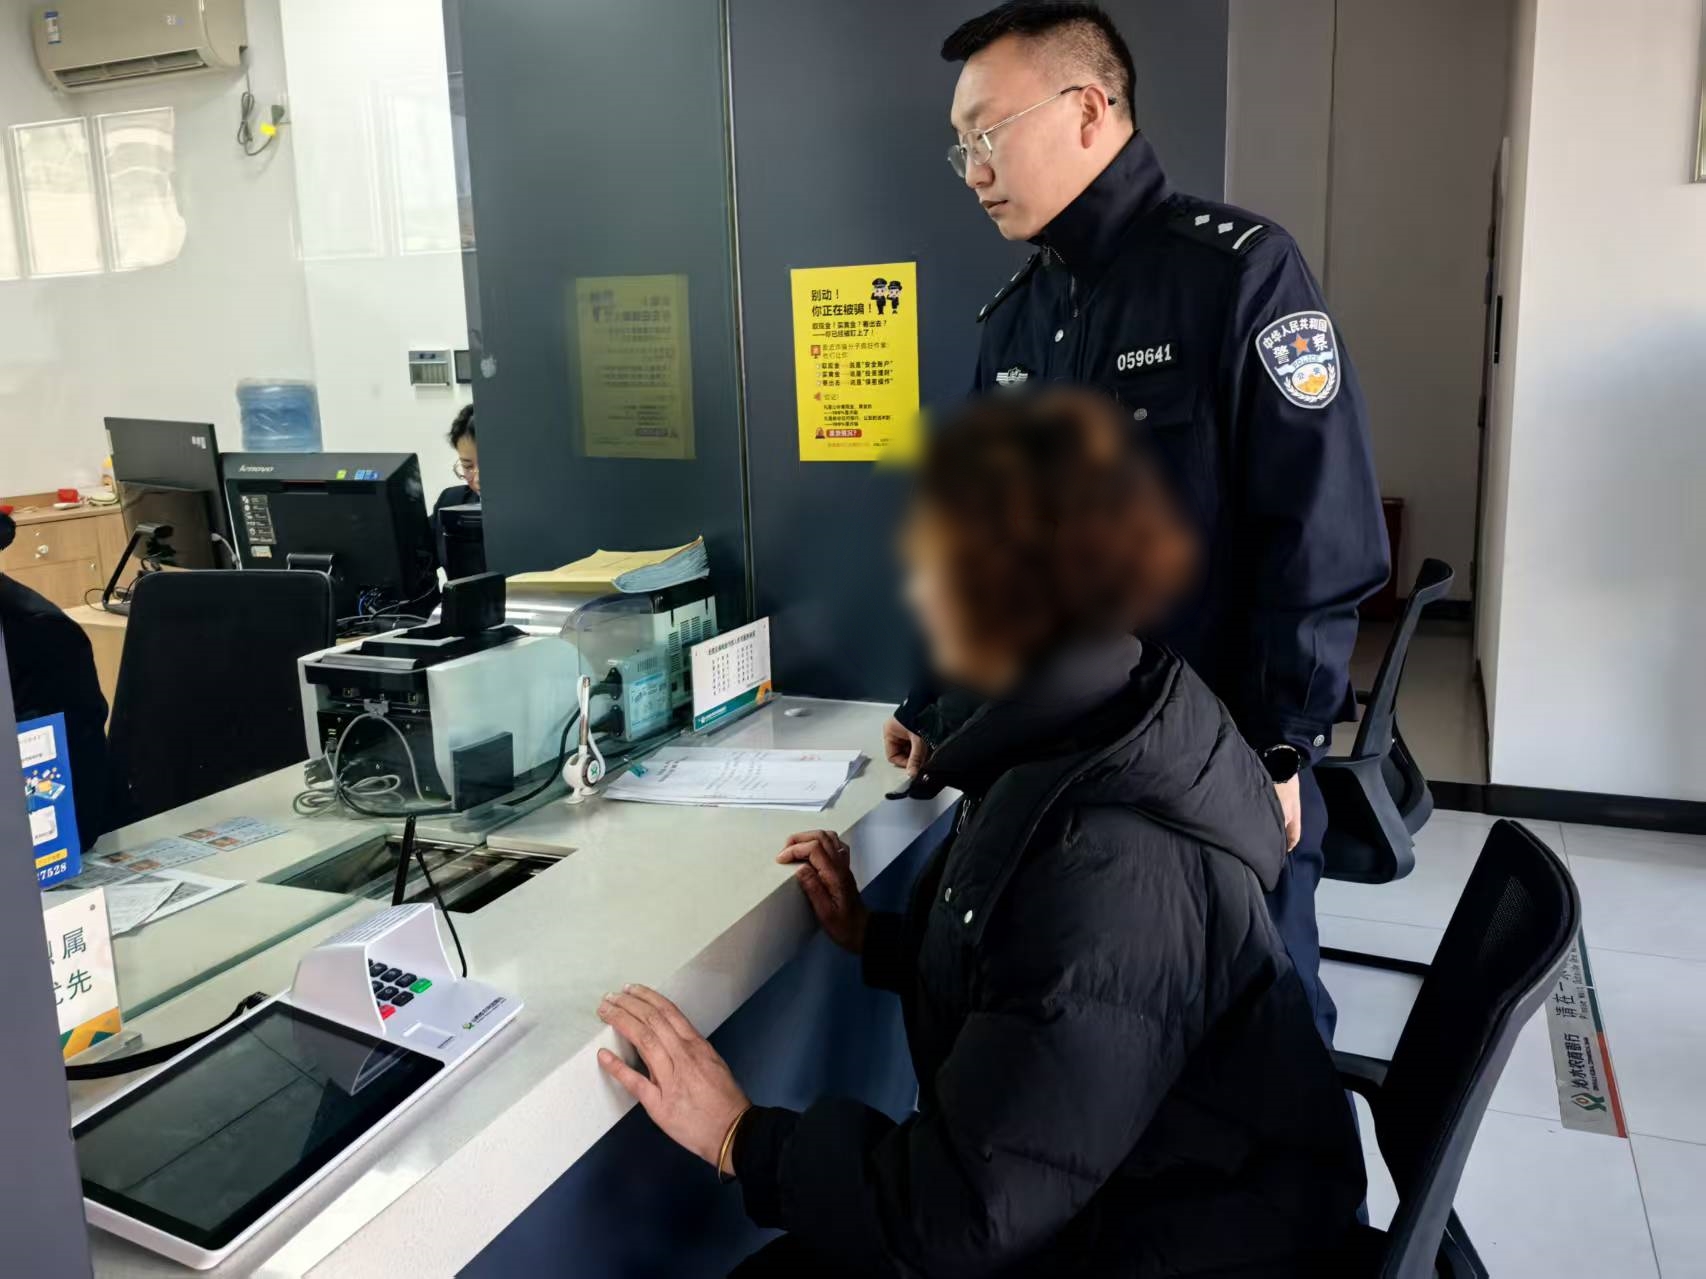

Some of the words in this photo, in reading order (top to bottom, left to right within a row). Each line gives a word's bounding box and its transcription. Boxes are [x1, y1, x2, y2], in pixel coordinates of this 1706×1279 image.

[811, 289, 839, 301] 别动！
[812, 303, 872, 316] 你正在被骗！
[1263, 318, 1328, 349] 中华人民共和国
[1117, 343, 1172, 371] 059641
[1292, 355, 1320, 368] POLICE
[48, 926, 87, 965] 属
